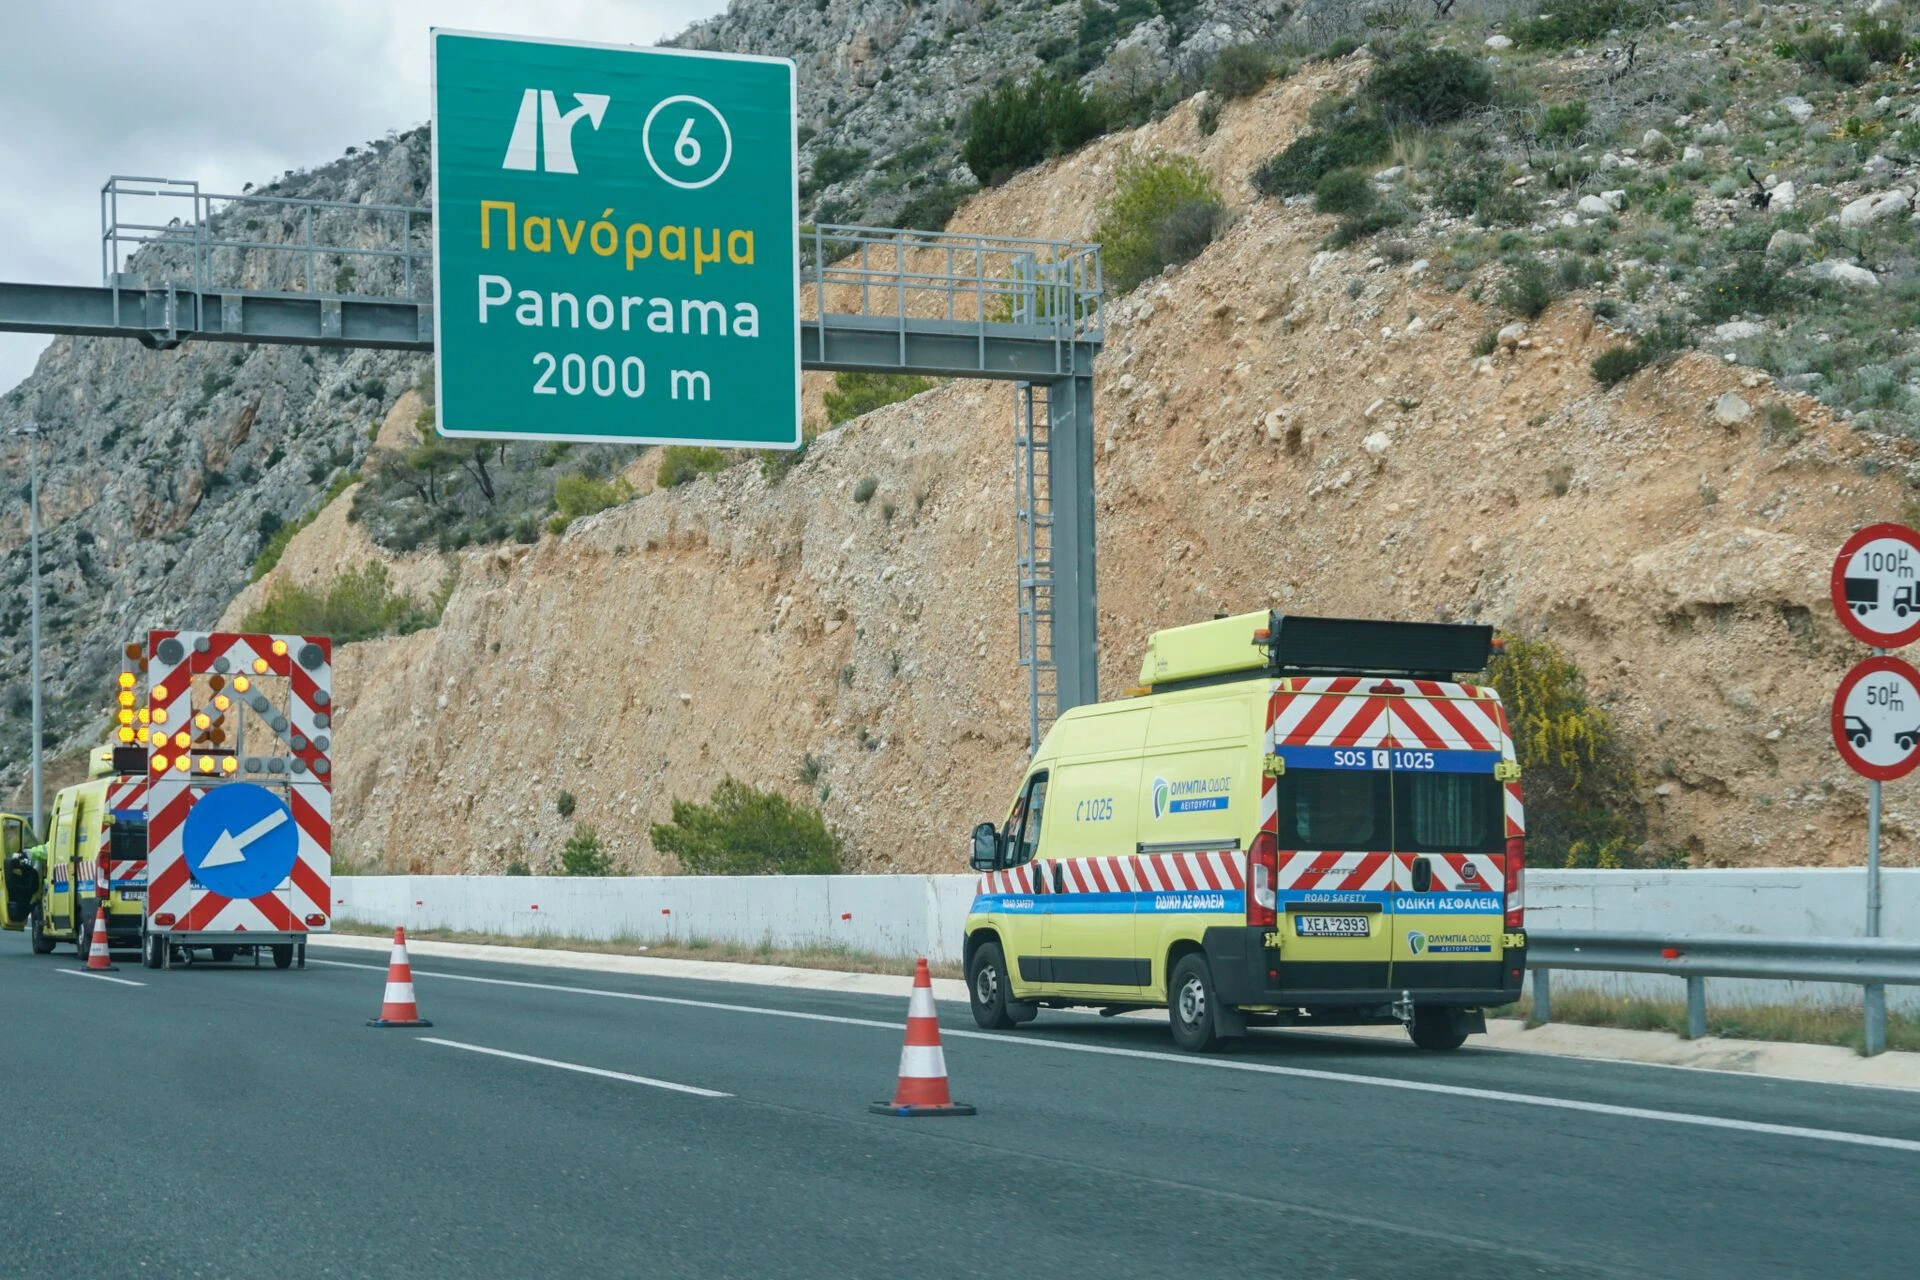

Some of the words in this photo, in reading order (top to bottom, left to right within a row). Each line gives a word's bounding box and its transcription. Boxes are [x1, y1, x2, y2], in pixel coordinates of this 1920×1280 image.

[674, 118, 701, 166] 6
[480, 200, 755, 275] Πανόραμα
[478, 274, 760, 338] Panorama
[532, 351, 646, 398] 2000
[670, 368, 711, 401] m
[1863, 551, 1897, 572] 100
[1866, 685, 1889, 706] 50
[1334, 750, 1366, 766] SOS
[1394, 751, 1435, 769] 1025
[1085, 798, 1113, 822] 1025
[1155, 894, 1181, 909] ΟΔΙΚΗ
[1181, 893, 1225, 909] ΑΣΦΑΛΕΙΑ
[1304, 893, 1330, 902] ROAD
[1332, 893, 1367, 903] SAFETY
[1396, 897, 1436, 910] ΟΔΙΚΗ
[1438, 897, 1501, 910] ΑΣΦΑΛΕΙΑ
[1428, 934, 1467, 943] ΟΛΥΜΠΙΑ
